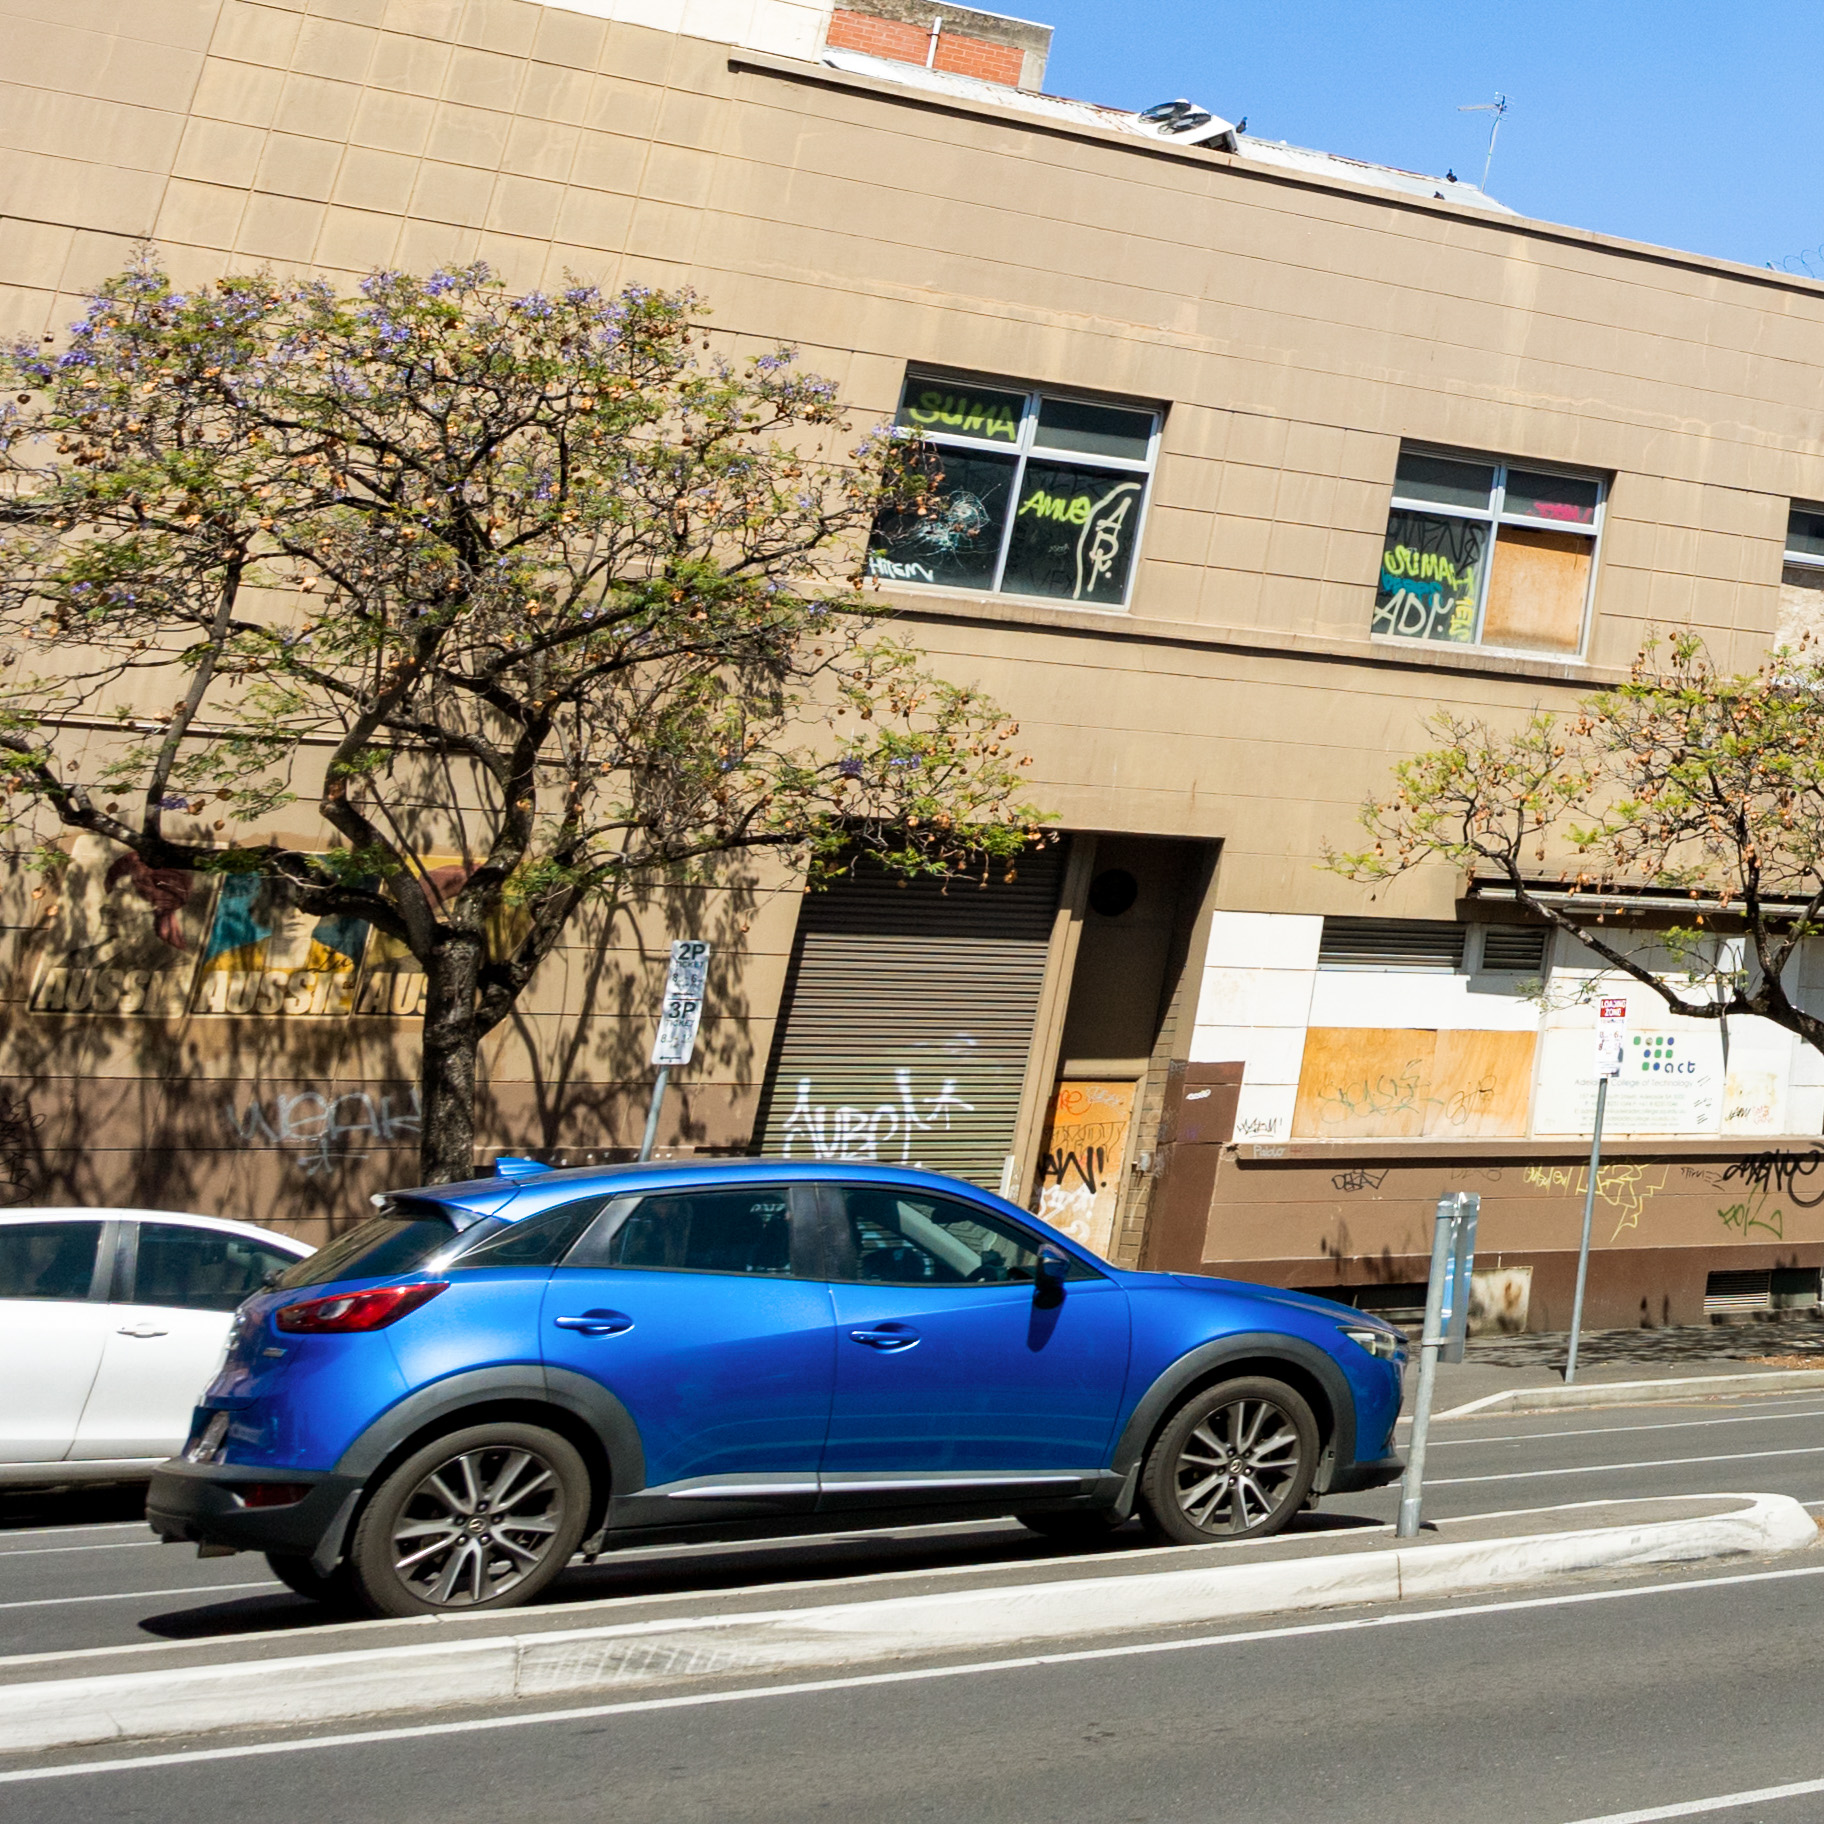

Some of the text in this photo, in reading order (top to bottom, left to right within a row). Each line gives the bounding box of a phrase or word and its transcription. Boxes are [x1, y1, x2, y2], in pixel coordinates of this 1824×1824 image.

[678, 943, 706, 960] 2P
[675, 961, 704, 969] TICKET
[200, 972, 353, 1015] AUSSIE
[668, 1001, 697, 1018] 3P
[666, 1020, 696, 1029] TICKET
[1664, 1061, 1696, 1074] act
[1610, 1078, 1640, 1088] College
[1642, 1079, 1650, 1087] of
[1651, 1078, 1693, 1088] Technology
